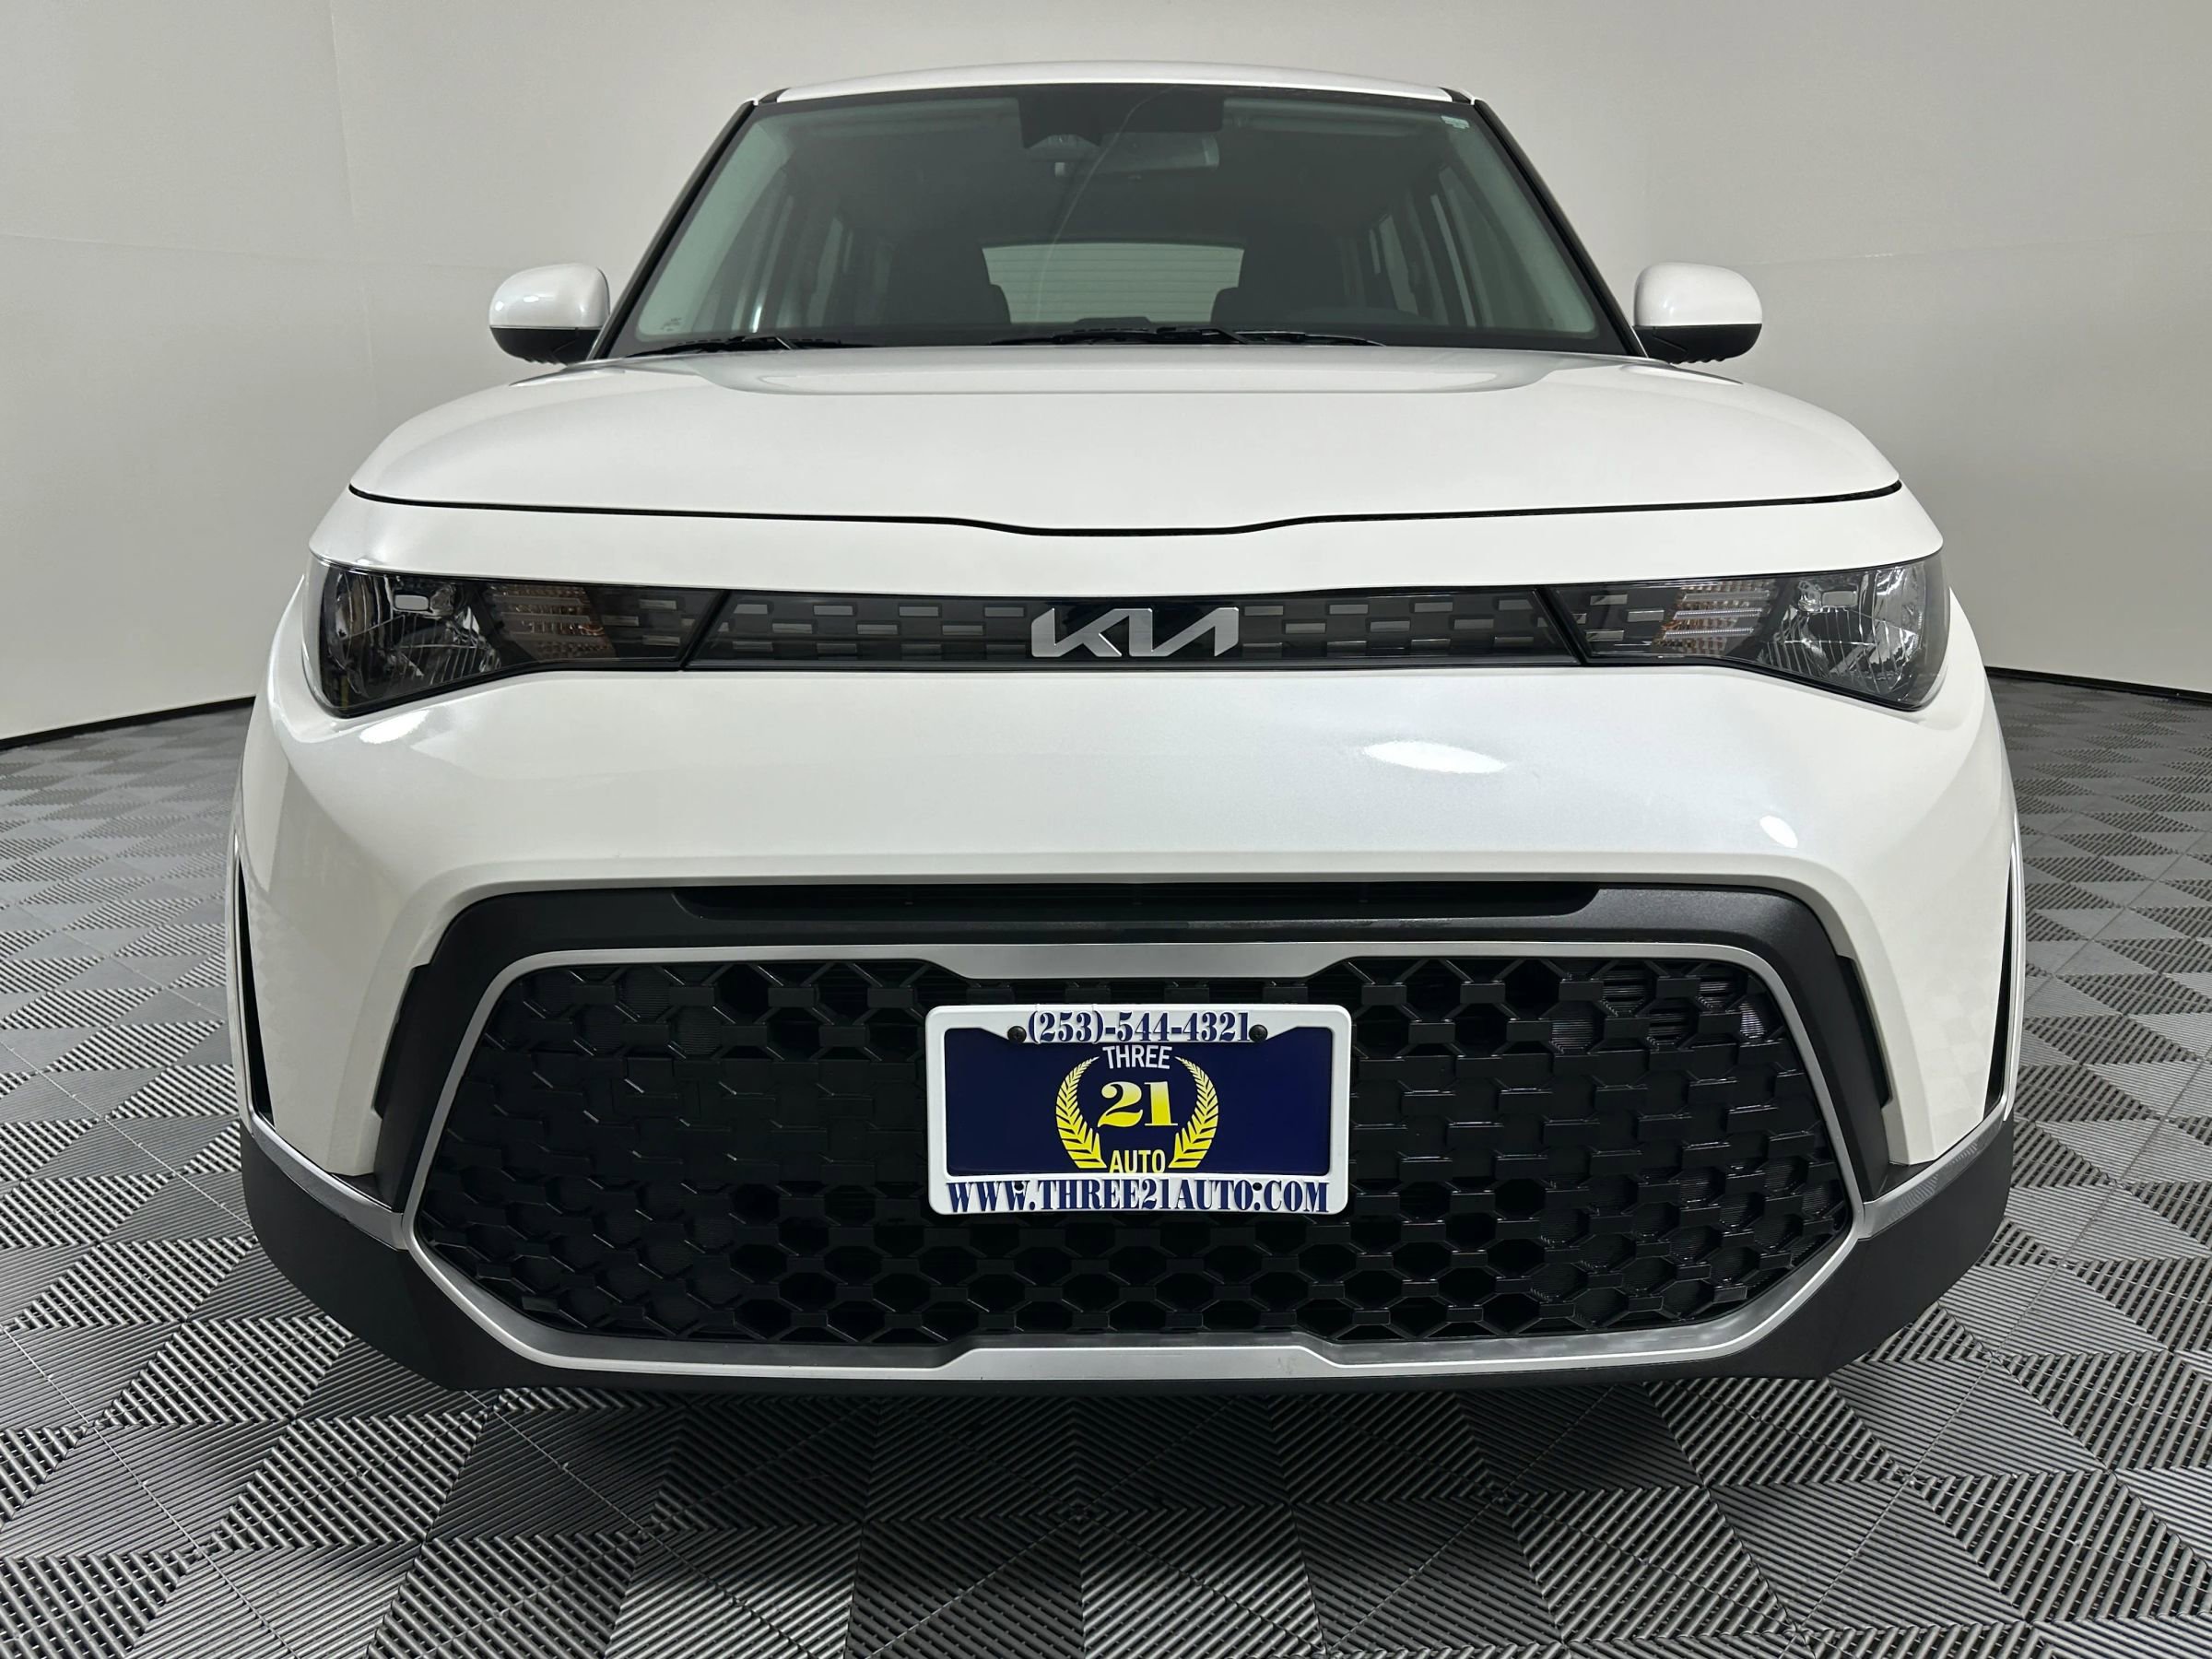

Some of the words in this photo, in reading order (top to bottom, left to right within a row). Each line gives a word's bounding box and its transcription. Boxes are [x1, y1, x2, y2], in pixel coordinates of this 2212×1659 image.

[1028, 1010, 1251, 1043] (253)-544-4321
[1102, 1044, 1173, 1069] THREE
[1098, 1081, 1178, 1128] 21
[1109, 1149, 1166, 1173] AUTO
[947, 1178, 1329, 1213] WWW.THREE21AUTO.COM
